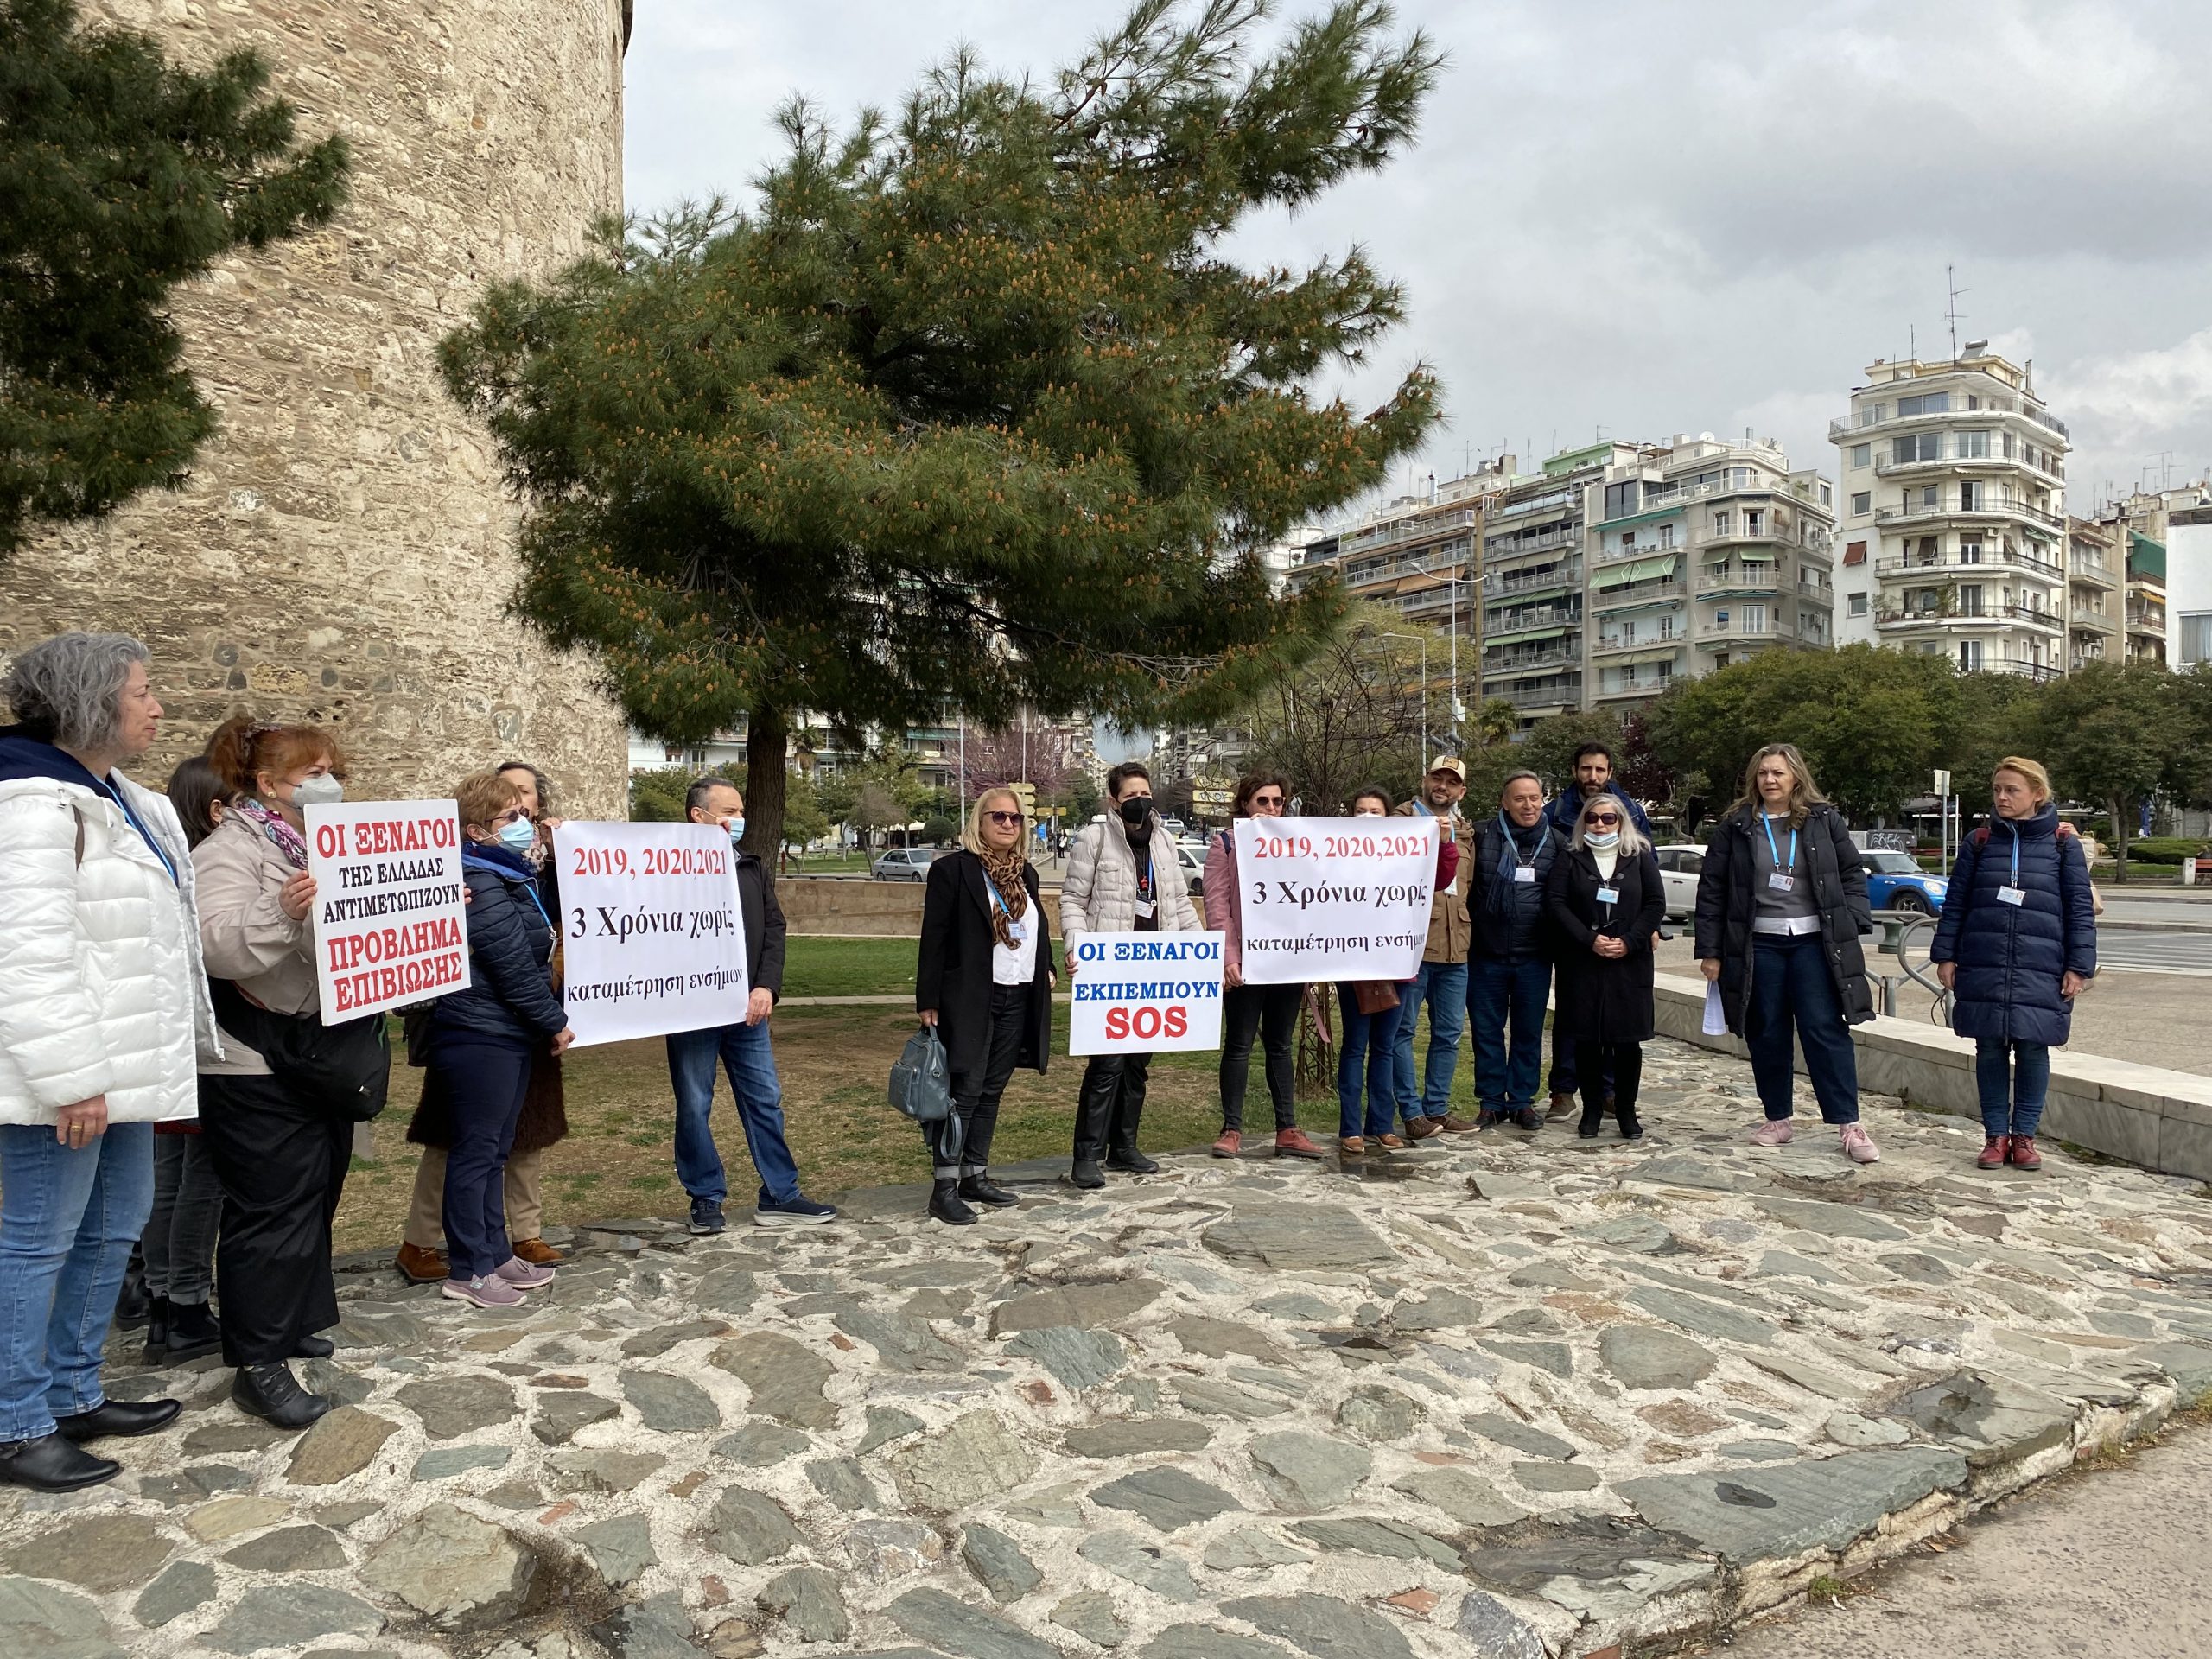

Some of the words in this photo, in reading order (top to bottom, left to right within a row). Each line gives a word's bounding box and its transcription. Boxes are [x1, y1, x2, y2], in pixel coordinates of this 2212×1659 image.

[316, 824, 347, 858] ΟΙ
[354, 817, 456, 855] ΞΕΝΑΓΟΙ
[1254, 836, 1319, 861] 2019,
[1325, 836, 1429, 861] 2020,2021
[339, 864, 372, 888] ΤΗΣ
[377, 857, 444, 884] ΕΛΛΑΔΑΣ
[573, 847, 636, 880] 2019,
[642, 848, 727, 879] 2020,2021
[323, 883, 460, 924] ΑΝΤΙΜΕΤΩΠΙΖΟΥΝ
[1252, 881, 1267, 905] 3
[1277, 880, 1367, 910] Χρόνια
[1374, 879, 1427, 908] χωρίς
[571, 907, 587, 938] 3
[596, 905, 683, 944] Χρόνια
[689, 901, 734, 939] χωρίς
[327, 916, 462, 972] ΠΡΟΒΛΗΜΑ
[1078, 942, 1106, 961] ΟΙ
[1114, 942, 1220, 961] ΞΕΝΑΓΟΙ
[1246, 933, 1369, 955] καταμέτρηση
[334, 951, 463, 1012] ΕΠΙΒΙΩΣΗΣ
[567, 974, 684, 1003] καταμέτρηση
[689, 965, 743, 991] ενσήμων
[1074, 981, 1220, 1001] ΕΚΠΕΜΠΟΥΝ
[1105, 1006, 1188, 1039] SOS
